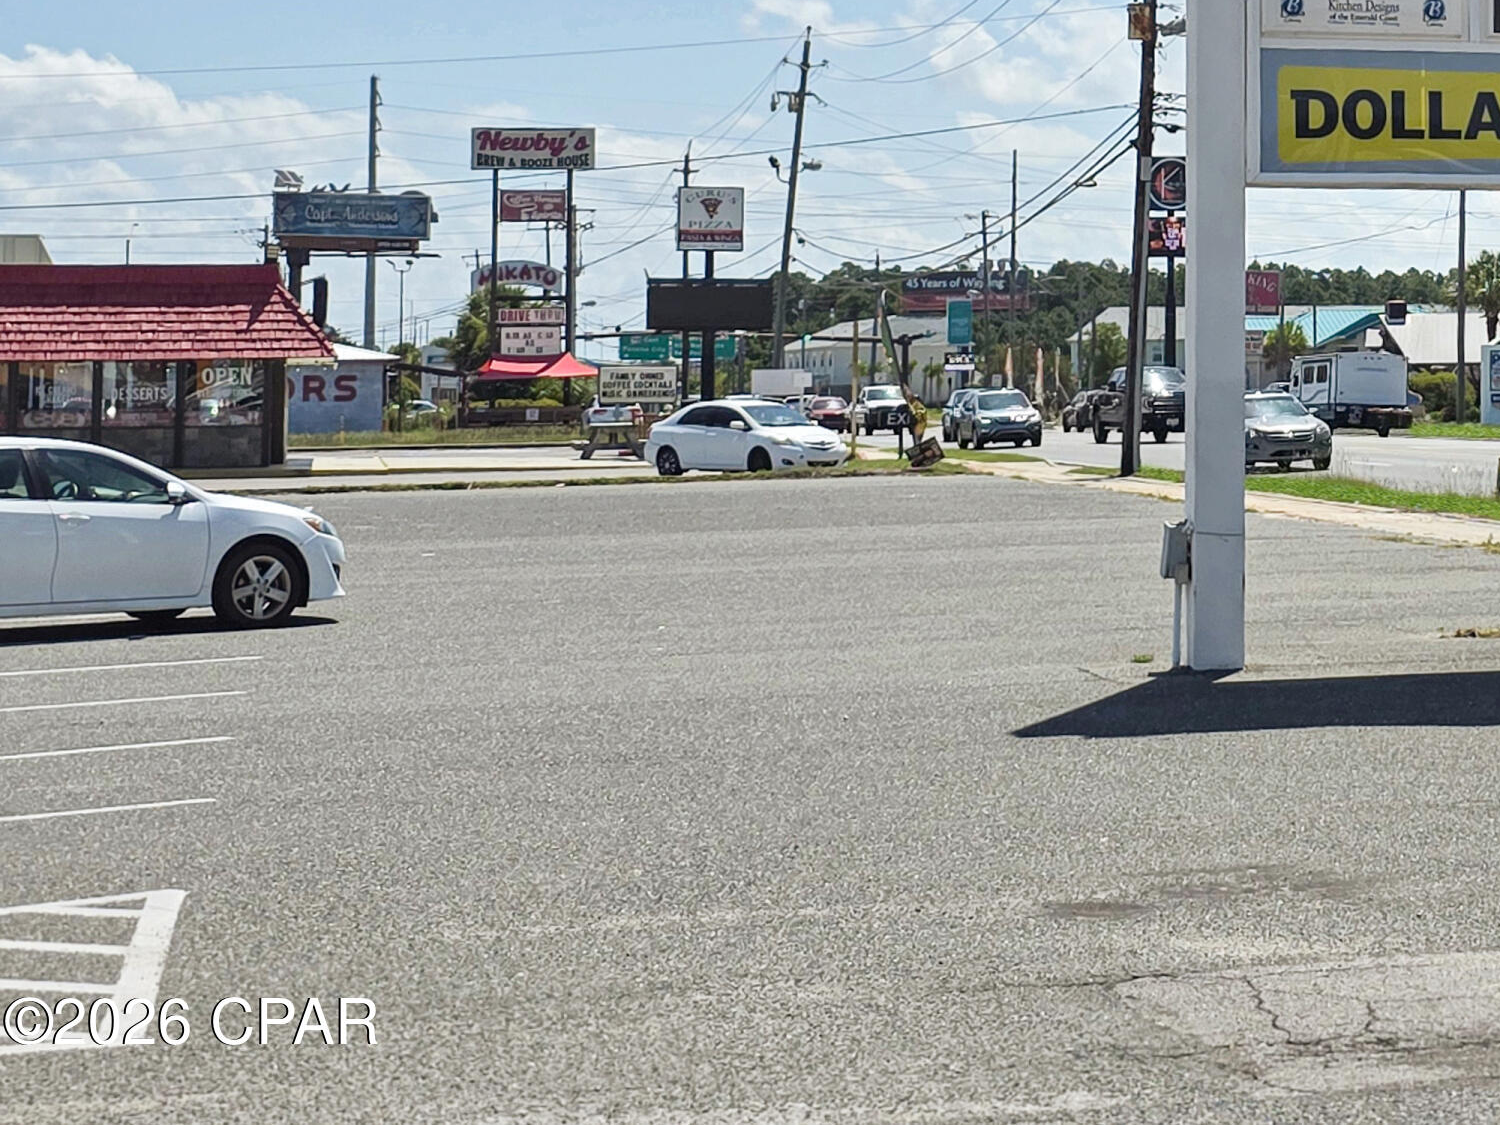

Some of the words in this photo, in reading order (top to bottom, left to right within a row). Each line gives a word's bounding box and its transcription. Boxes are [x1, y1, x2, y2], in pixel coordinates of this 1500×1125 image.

[1365, 0, 1400, 16] Designs
[476, 130, 591, 157] Newby's
[557, 153, 590, 167] HOUSE
[687, 219, 733, 229] PIZZA
[906, 279, 919, 289] 45
[920, 277, 948, 289] Years
[949, 277, 960, 289] of
[500, 308, 531, 322] DRIVE
[201, 366, 252, 387] OPEN
[111, 386, 168, 402] DESSERTS
